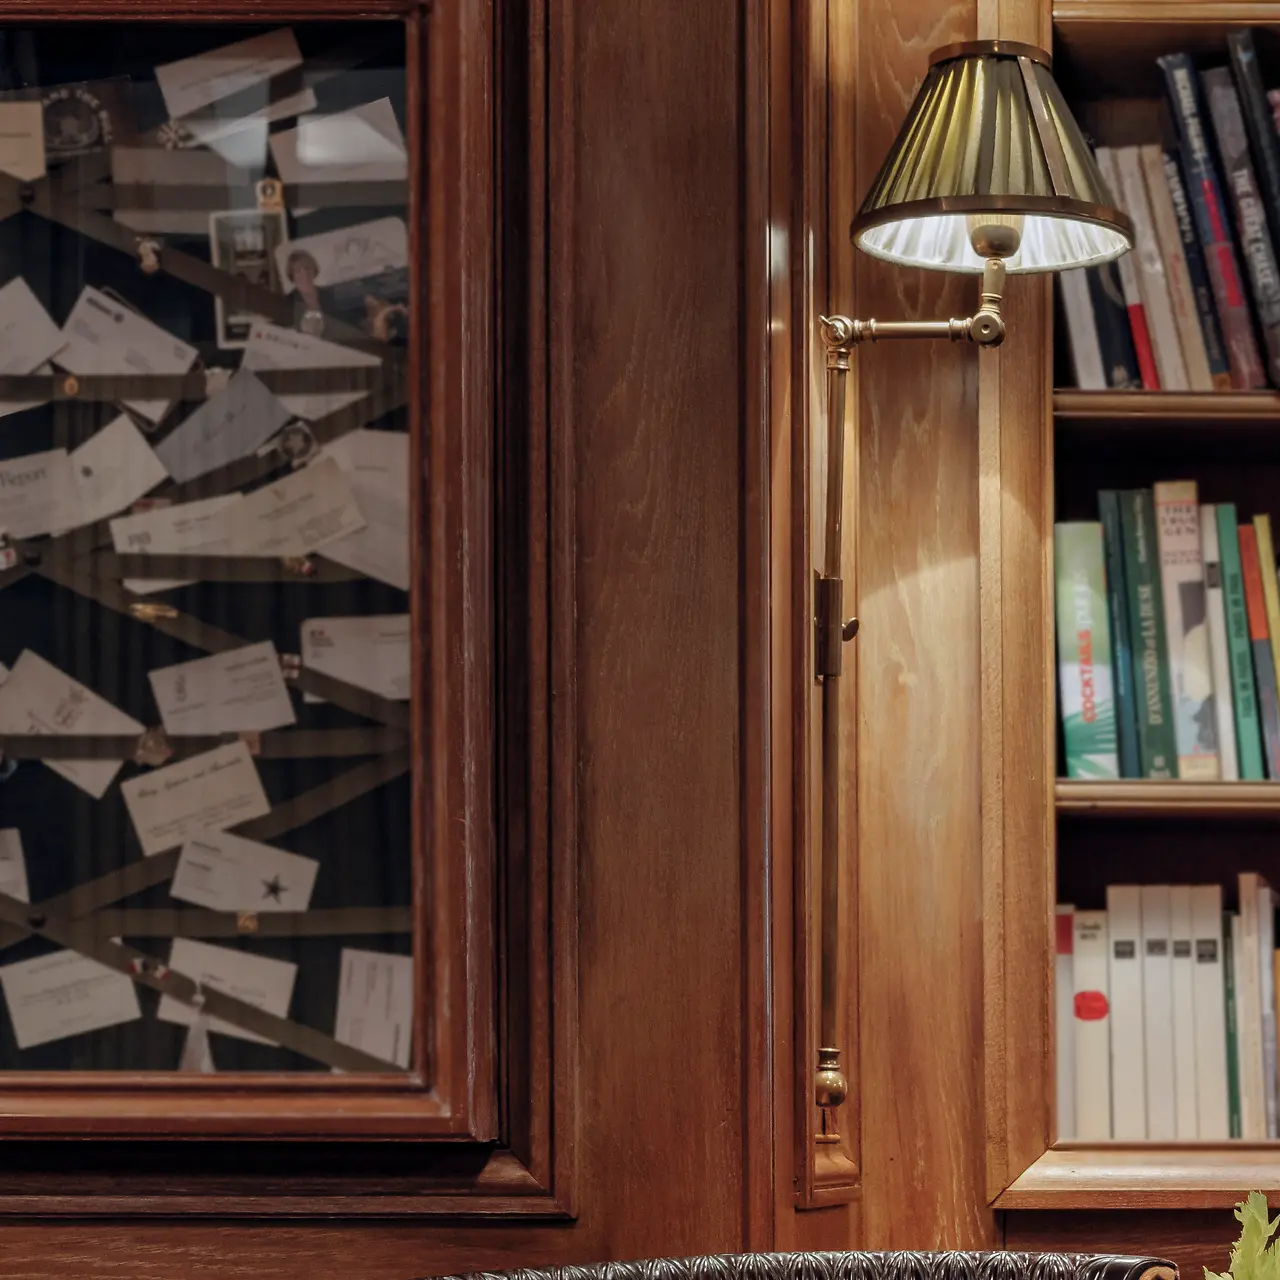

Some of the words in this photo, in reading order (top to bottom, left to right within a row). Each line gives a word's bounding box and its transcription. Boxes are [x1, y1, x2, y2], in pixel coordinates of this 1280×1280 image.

[1232, 169, 1252, 196] THE
[1238, 197, 1266, 241] GREAT
[1249, 243, 1275, 287] CHASE
[1164, 505, 1192, 515] THE
[1164, 526, 1197, 536] GEN
[1138, 584, 1155, 618] DUSE
[1140, 619, 1157, 637] LA
[1077, 629, 1097, 723] COCKTAILS
[1142, 650, 1163, 725] D'ANNUNZIO
